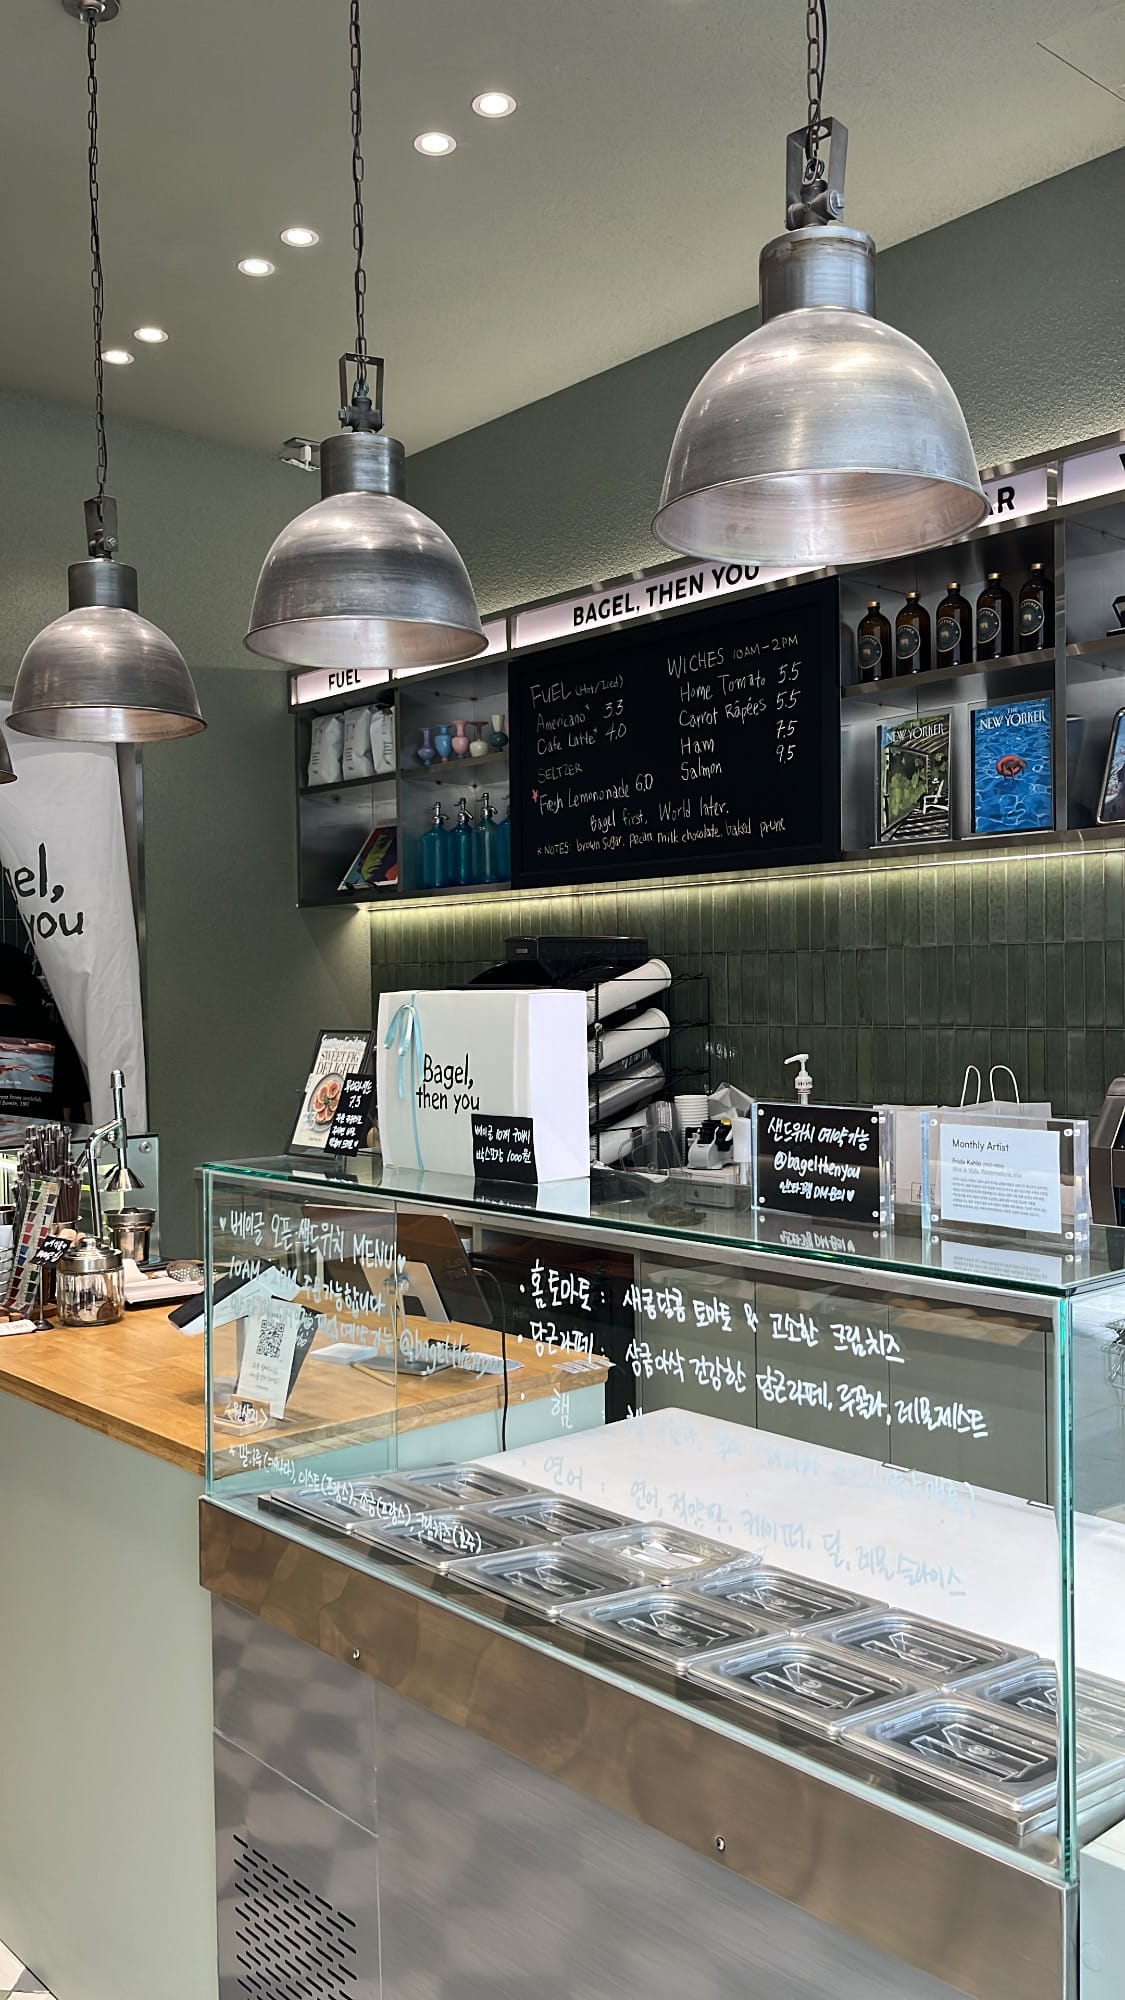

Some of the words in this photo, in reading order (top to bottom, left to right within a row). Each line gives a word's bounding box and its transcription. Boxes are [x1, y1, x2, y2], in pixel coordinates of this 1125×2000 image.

[573, 592, 640, 626] BAGEL,
[646, 572, 703, 607] THEN
[712, 564, 760, 588] YOU
[328, 668, 361, 690] FUEL
[529, 681, 572, 709] FUEL
[680, 682, 713, 702] Home
[717, 669, 766, 695] Tomato
[778, 661, 802, 684] 5.5
[679, 707, 718, 728] Carrot
[776, 689, 801, 710] 5.5
[980, 716, 1003, 730] NEW
[1005, 709, 1047, 727] YORKER
[680, 737, 715, 755] Ham
[776, 720, 798, 739] 7.5
[886, 729, 906, 742] NEW
[908, 723, 945, 740] YORKER
[538, 763, 583, 784] SELTZER
[681, 757, 722, 781] Salmon
[776, 744, 796, 764] 9.5
[635, 773, 654, 792] 6.0
[590, 808, 616, 834] Bagel
[658, 798, 691, 822] World
[576, 839, 601, 852] brown
[657, 828, 679, 844] milk
[423, 1053, 474, 1090] Bagel,
[416, 1083, 447, 1110] then
[454, 1093, 480, 1114] you
[952, 1138, 985, 1152] Monthly
[986, 1141, 1009, 1152] Artist
[774, 1150, 860, 1182] @bagelthenyou
[231, 1210, 265, 1247] 베이글
[271, 1214, 294, 1250] 오픈
[353, 1233, 397, 1270] MENU
[693, 1296, 733, 1333] 토마토
[769, 1312, 819, 1348] 고소한
[830, 1323, 905, 1364] 크림치즈
